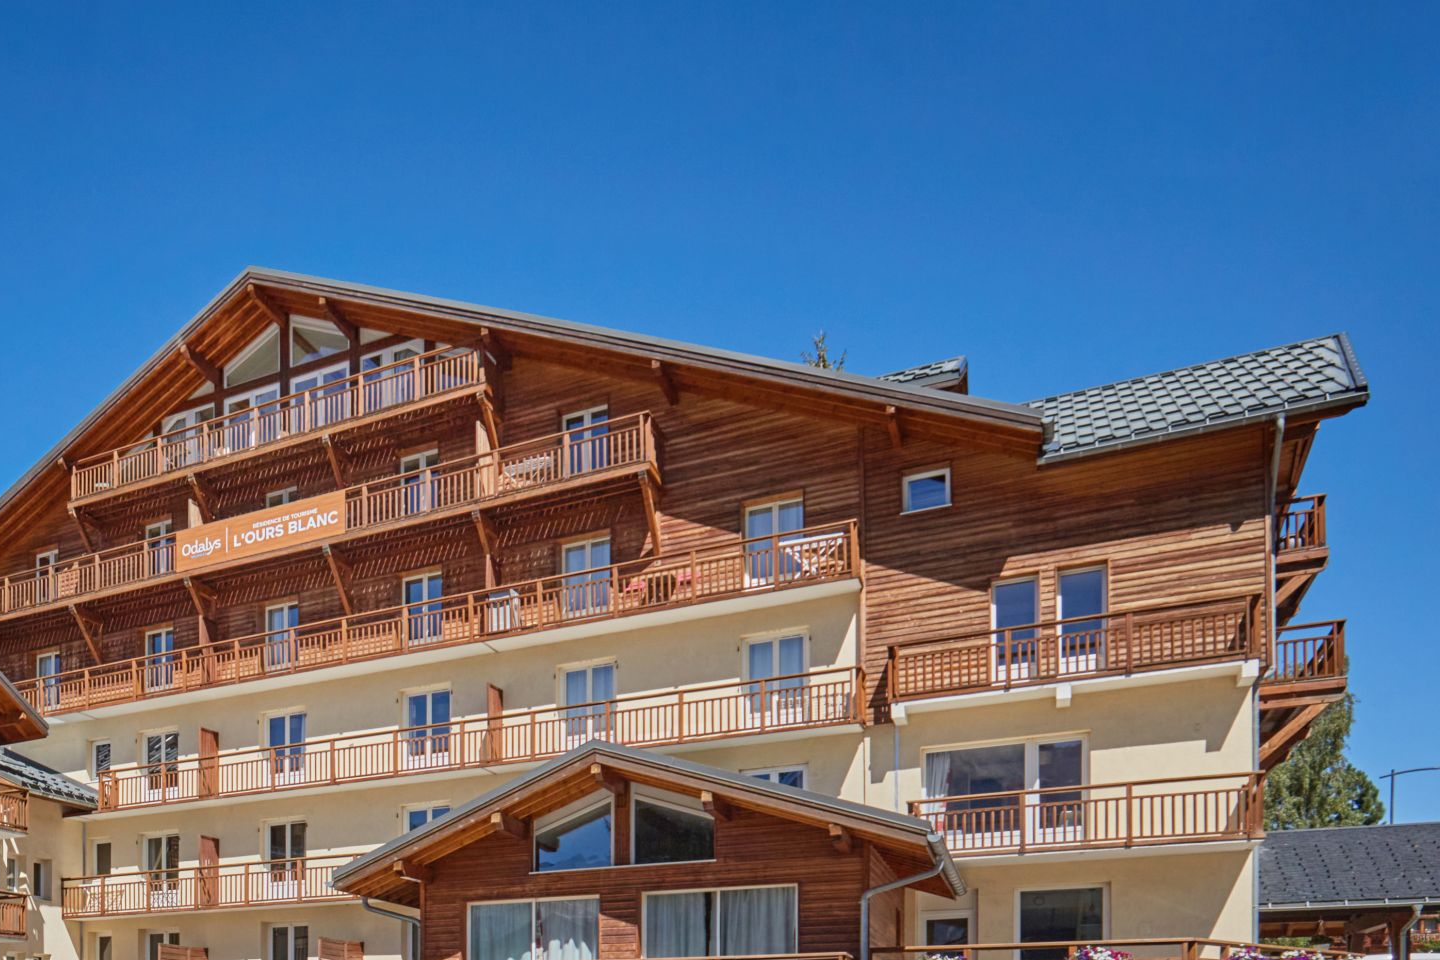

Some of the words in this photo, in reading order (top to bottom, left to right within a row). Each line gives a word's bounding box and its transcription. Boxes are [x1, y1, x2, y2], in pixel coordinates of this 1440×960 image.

[233, 524, 284, 548] L'OURS
[288, 511, 338, 534] BLANC
[182, 536, 221, 556] Odalys
